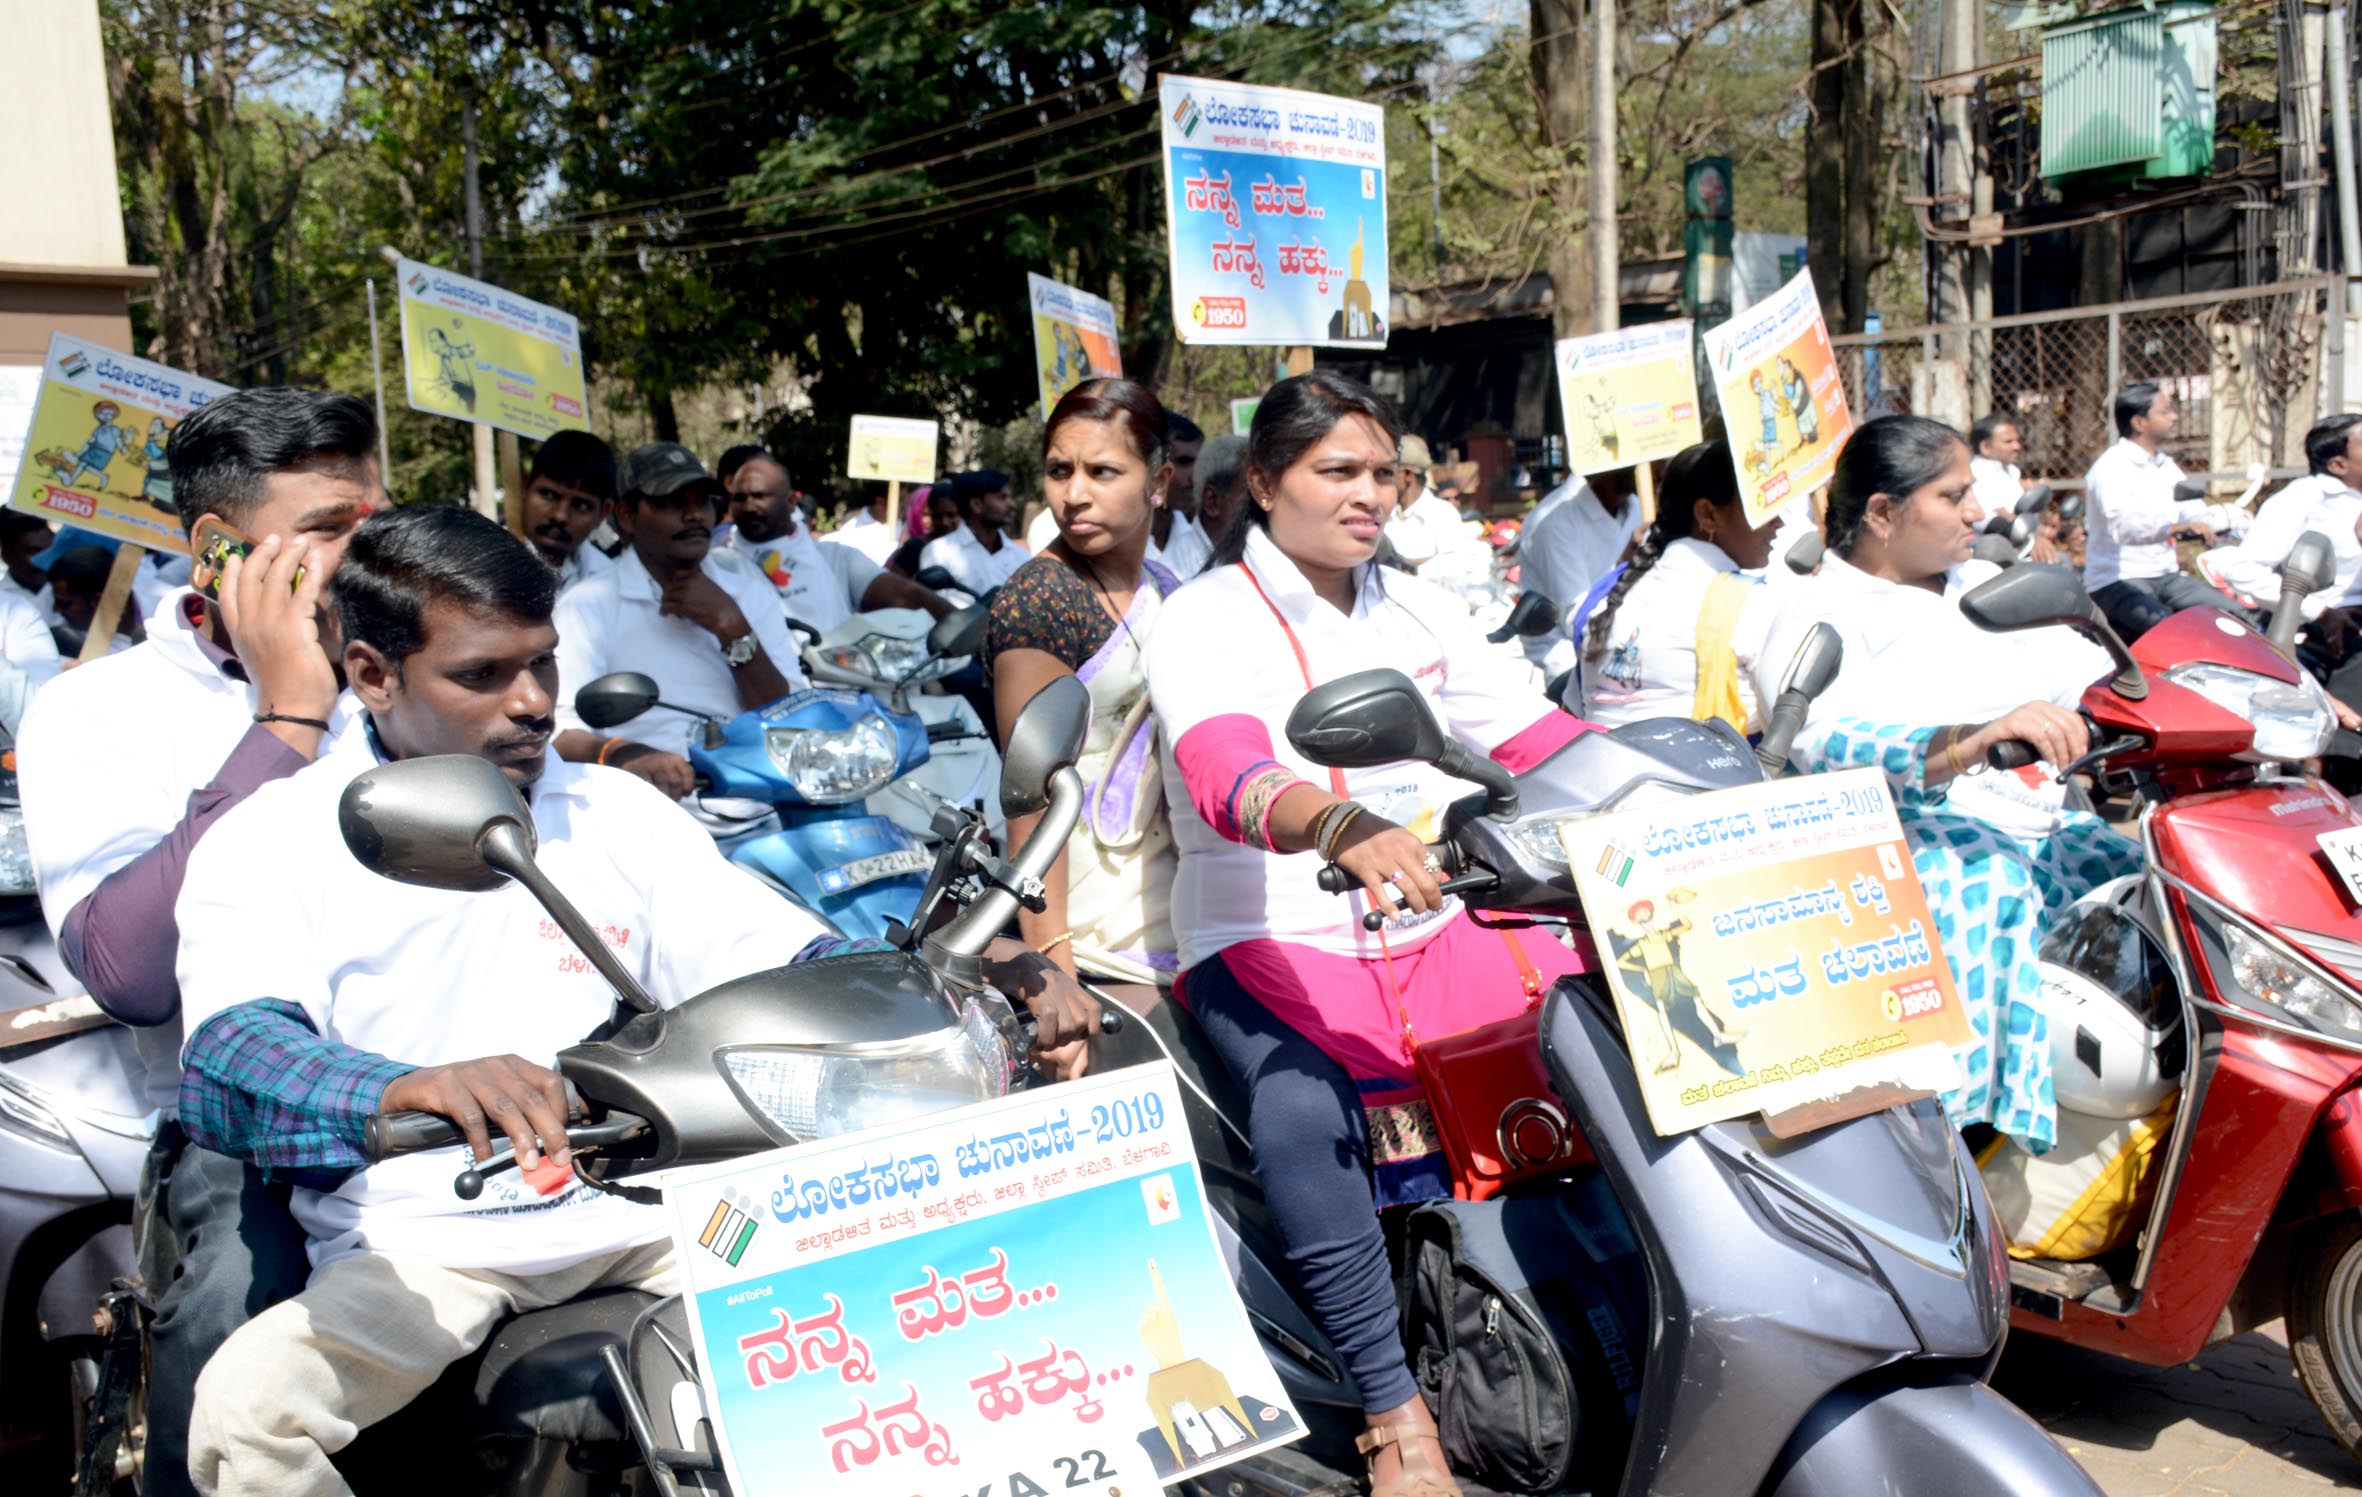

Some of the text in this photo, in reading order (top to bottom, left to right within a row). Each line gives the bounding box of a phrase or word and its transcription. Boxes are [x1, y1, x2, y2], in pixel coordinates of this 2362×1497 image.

[1185, 168, 1240, 228] ನನ್ನ
[1211, 232, 1265, 289] ನನ್ನ
[1207, 308, 1244, 325] 1950
[49, 494, 93, 518] 1950
[1711, 880, 1852, 938] ಜನಸಾಮಾನ್ಯ
[1726, 921, 1930, 1009] ಮತ ಚಲಾವಣೆ
[1900, 990, 1943, 1017] 1950
[770, 1092, 1166, 1224] ಲೋಕಸಭಾ ಚುನಾವಣೆ-2019
[795, 1216, 871, 1253] ಜಿಲ್ಲಾಡಳಿತ
[879, 1207, 916, 1231] ಮತ್ತು
[993, 1180, 1026, 1201] ಜಿಲ್ಲಾ
[1032, 1168, 1068, 1199] ಸ್ವೀಪ್
[1122, 1141, 1172, 1167] ಬೆಳಗಾವಿ
[726, 1285, 774, 1307] #AllToPoll
[738, 1246, 1059, 1390] ನನ್ನ ಮತ...
[821, 1337, 1135, 1475] ನನ್ನ ಹಕ್ಕು...
[1052, 1449, 1119, 1489] 22
